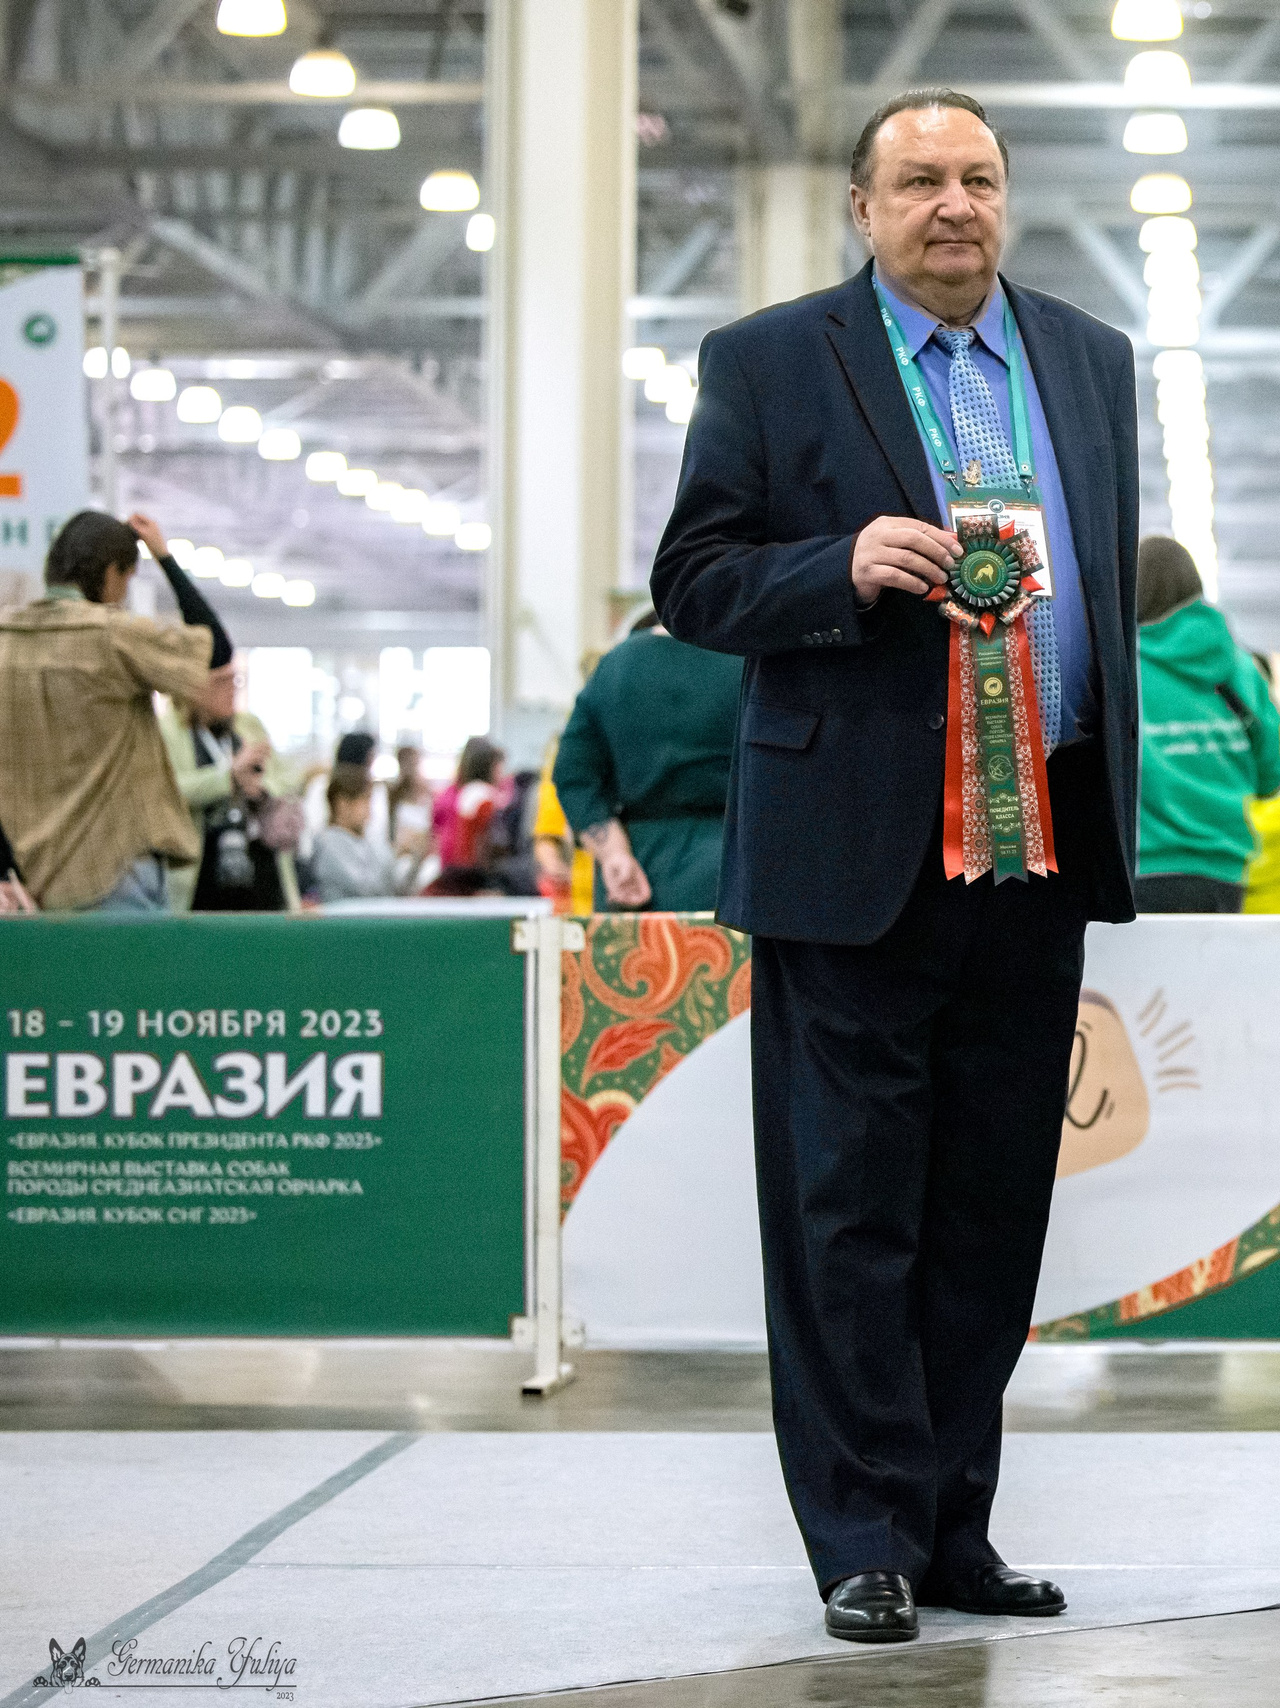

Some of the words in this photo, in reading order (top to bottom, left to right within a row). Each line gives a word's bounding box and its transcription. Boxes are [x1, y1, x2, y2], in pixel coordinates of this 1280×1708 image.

[896, 346, 909, 366] РКФ
[912, 386, 926, 407] РКФ
[929, 428, 942, 448] РКФ
[980, 697, 1009, 706] ЕВРАЗИЯ
[8, 1009, 46, 1038] 18
[87, 1009, 125, 1038] 19
[137, 1009, 287, 1038] НОЯБРЯ
[300, 1009, 384, 1038] 2023
[6, 1051, 384, 1119] ЕВРАЗИЯ
[104, 1132, 164, 1150] КУБОК
[167, 1132, 288, 1151] ПРЕЗИДЕНТА
[7, 1160, 121, 1177] ВСЕМИРНАЯ
[123, 1160, 223, 1177] ВЫСТАВКА
[226, 1160, 291, 1177] СОБАК
[7, 1178, 88, 1196] ПОРОДЫ
[102, 1206, 164, 1224] КУБОК
